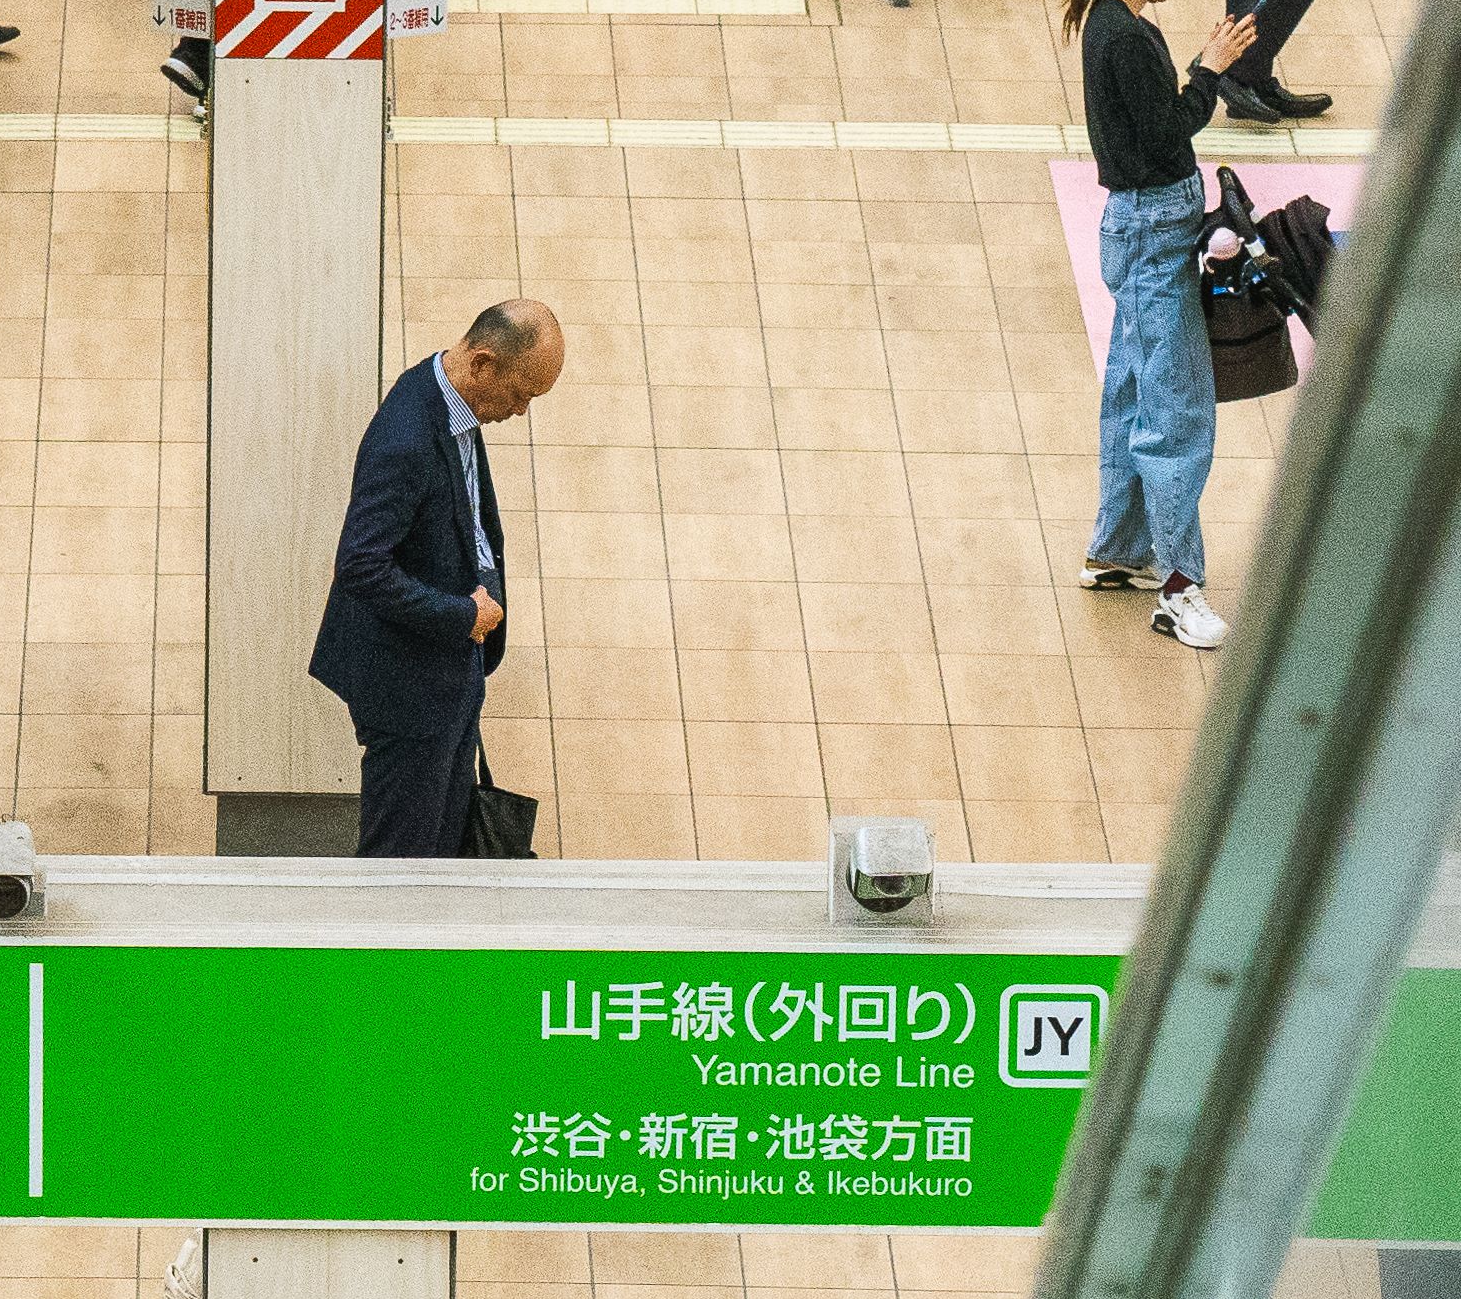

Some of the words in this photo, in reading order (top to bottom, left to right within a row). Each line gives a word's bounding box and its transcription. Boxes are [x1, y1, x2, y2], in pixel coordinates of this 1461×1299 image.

[540, 979, 979, 1044] 山手線(外回り)
[1023, 1014, 1084, 1057] JY
[691, 1054, 881, 1088] Yamanote
[896, 1055, 976, 1089] Line
[510, 1111, 973, 1162] 渋谷・新宿・池袋方面
[470, 1166, 511, 1192] for
[519, 1166, 646, 1200] Shibuya,
[658, 1167, 785, 1201] Shinjuku
[795, 1168, 816, 1196] &
[828, 1168, 973, 1197] Ikebukuro
